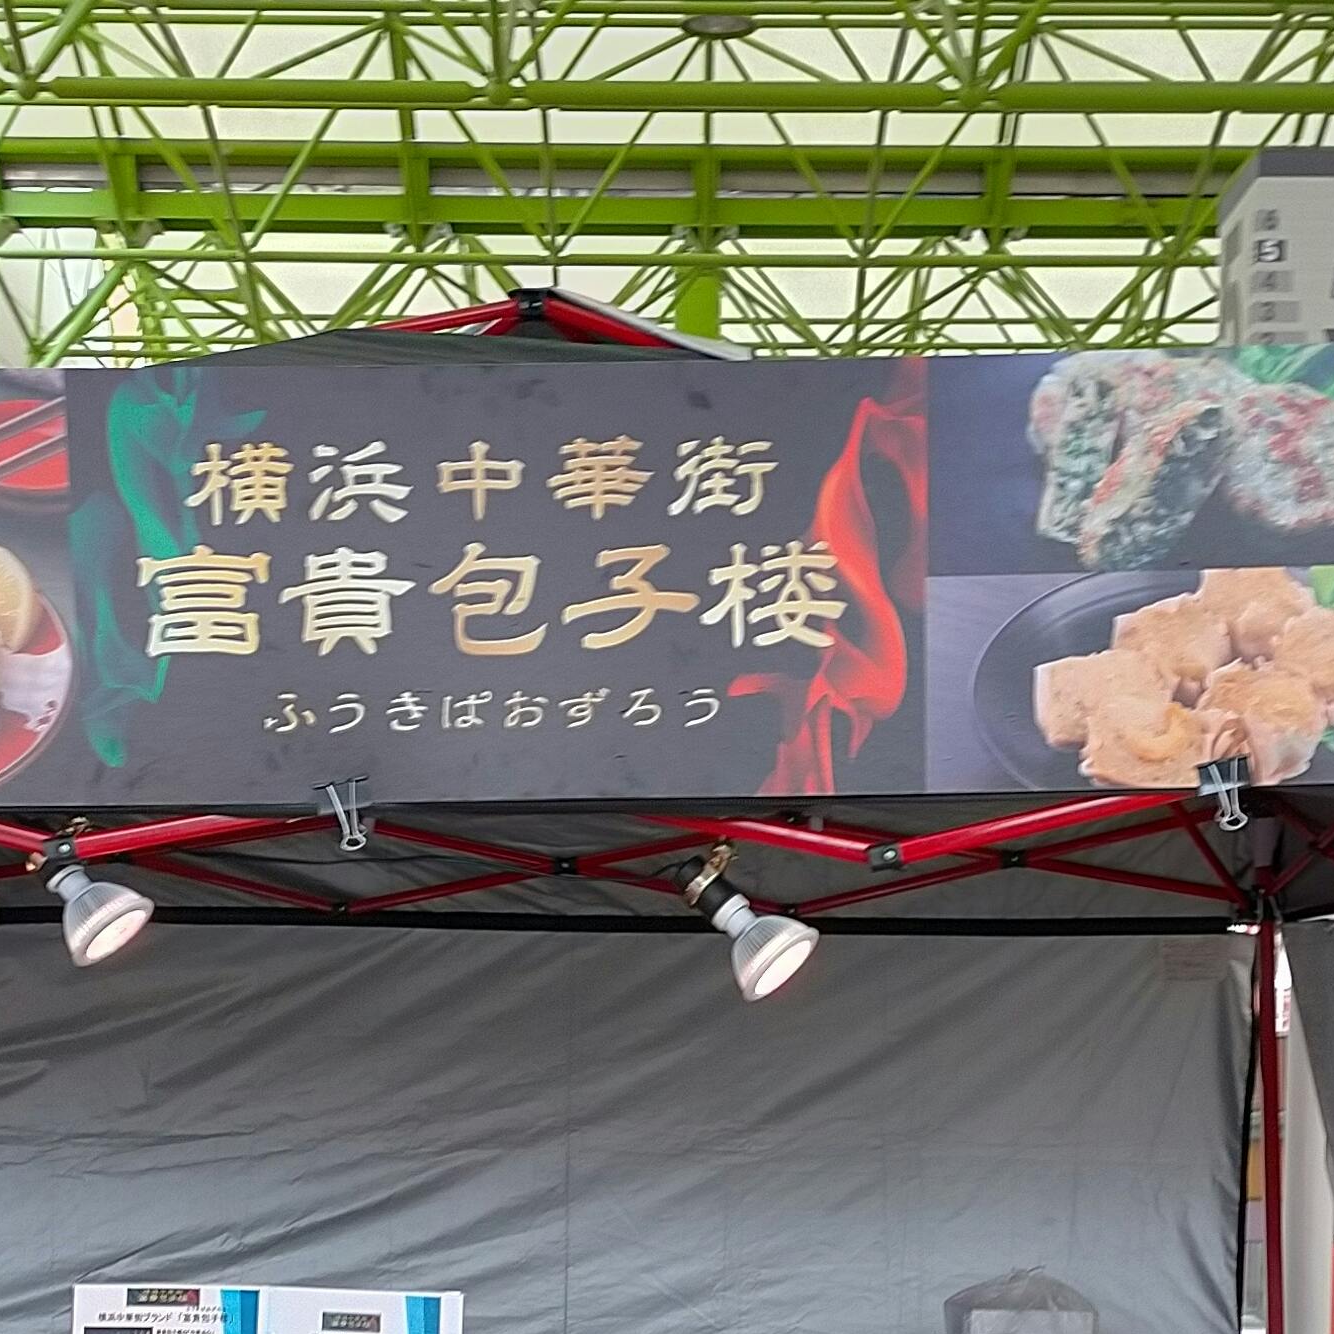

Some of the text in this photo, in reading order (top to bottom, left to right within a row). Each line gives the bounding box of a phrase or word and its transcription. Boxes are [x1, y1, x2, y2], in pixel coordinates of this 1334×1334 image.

[182, 434, 782, 528] 横浜中華街
[134, 541, 849, 659] 富貴包子楼
[261, 687, 724, 735] ふうきぱおずろう
